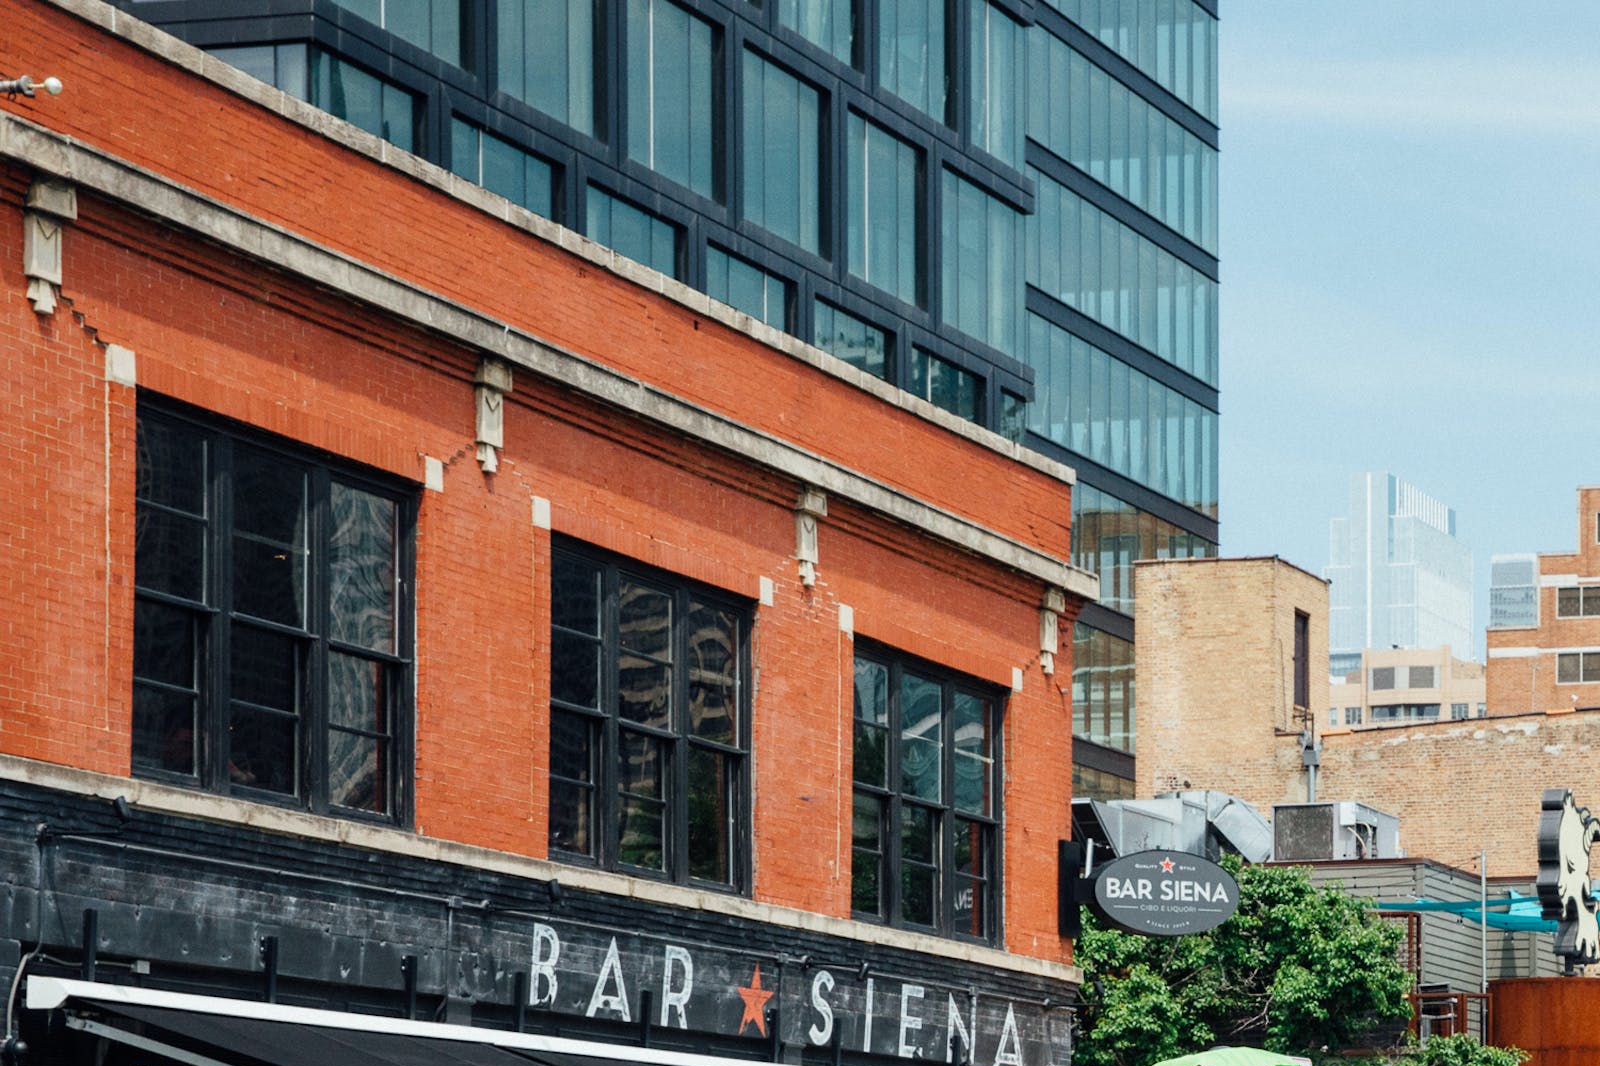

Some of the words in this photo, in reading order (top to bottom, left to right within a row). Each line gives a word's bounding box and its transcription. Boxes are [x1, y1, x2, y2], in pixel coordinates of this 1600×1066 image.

[1106, 877, 1153, 900] BAR
[1160, 879, 1230, 904] SIENA
[1140, 904, 1160, 912] CIBO
[1167, 905, 1197, 914] LIQUORI
[529, 922, 694, 1031] BAR
